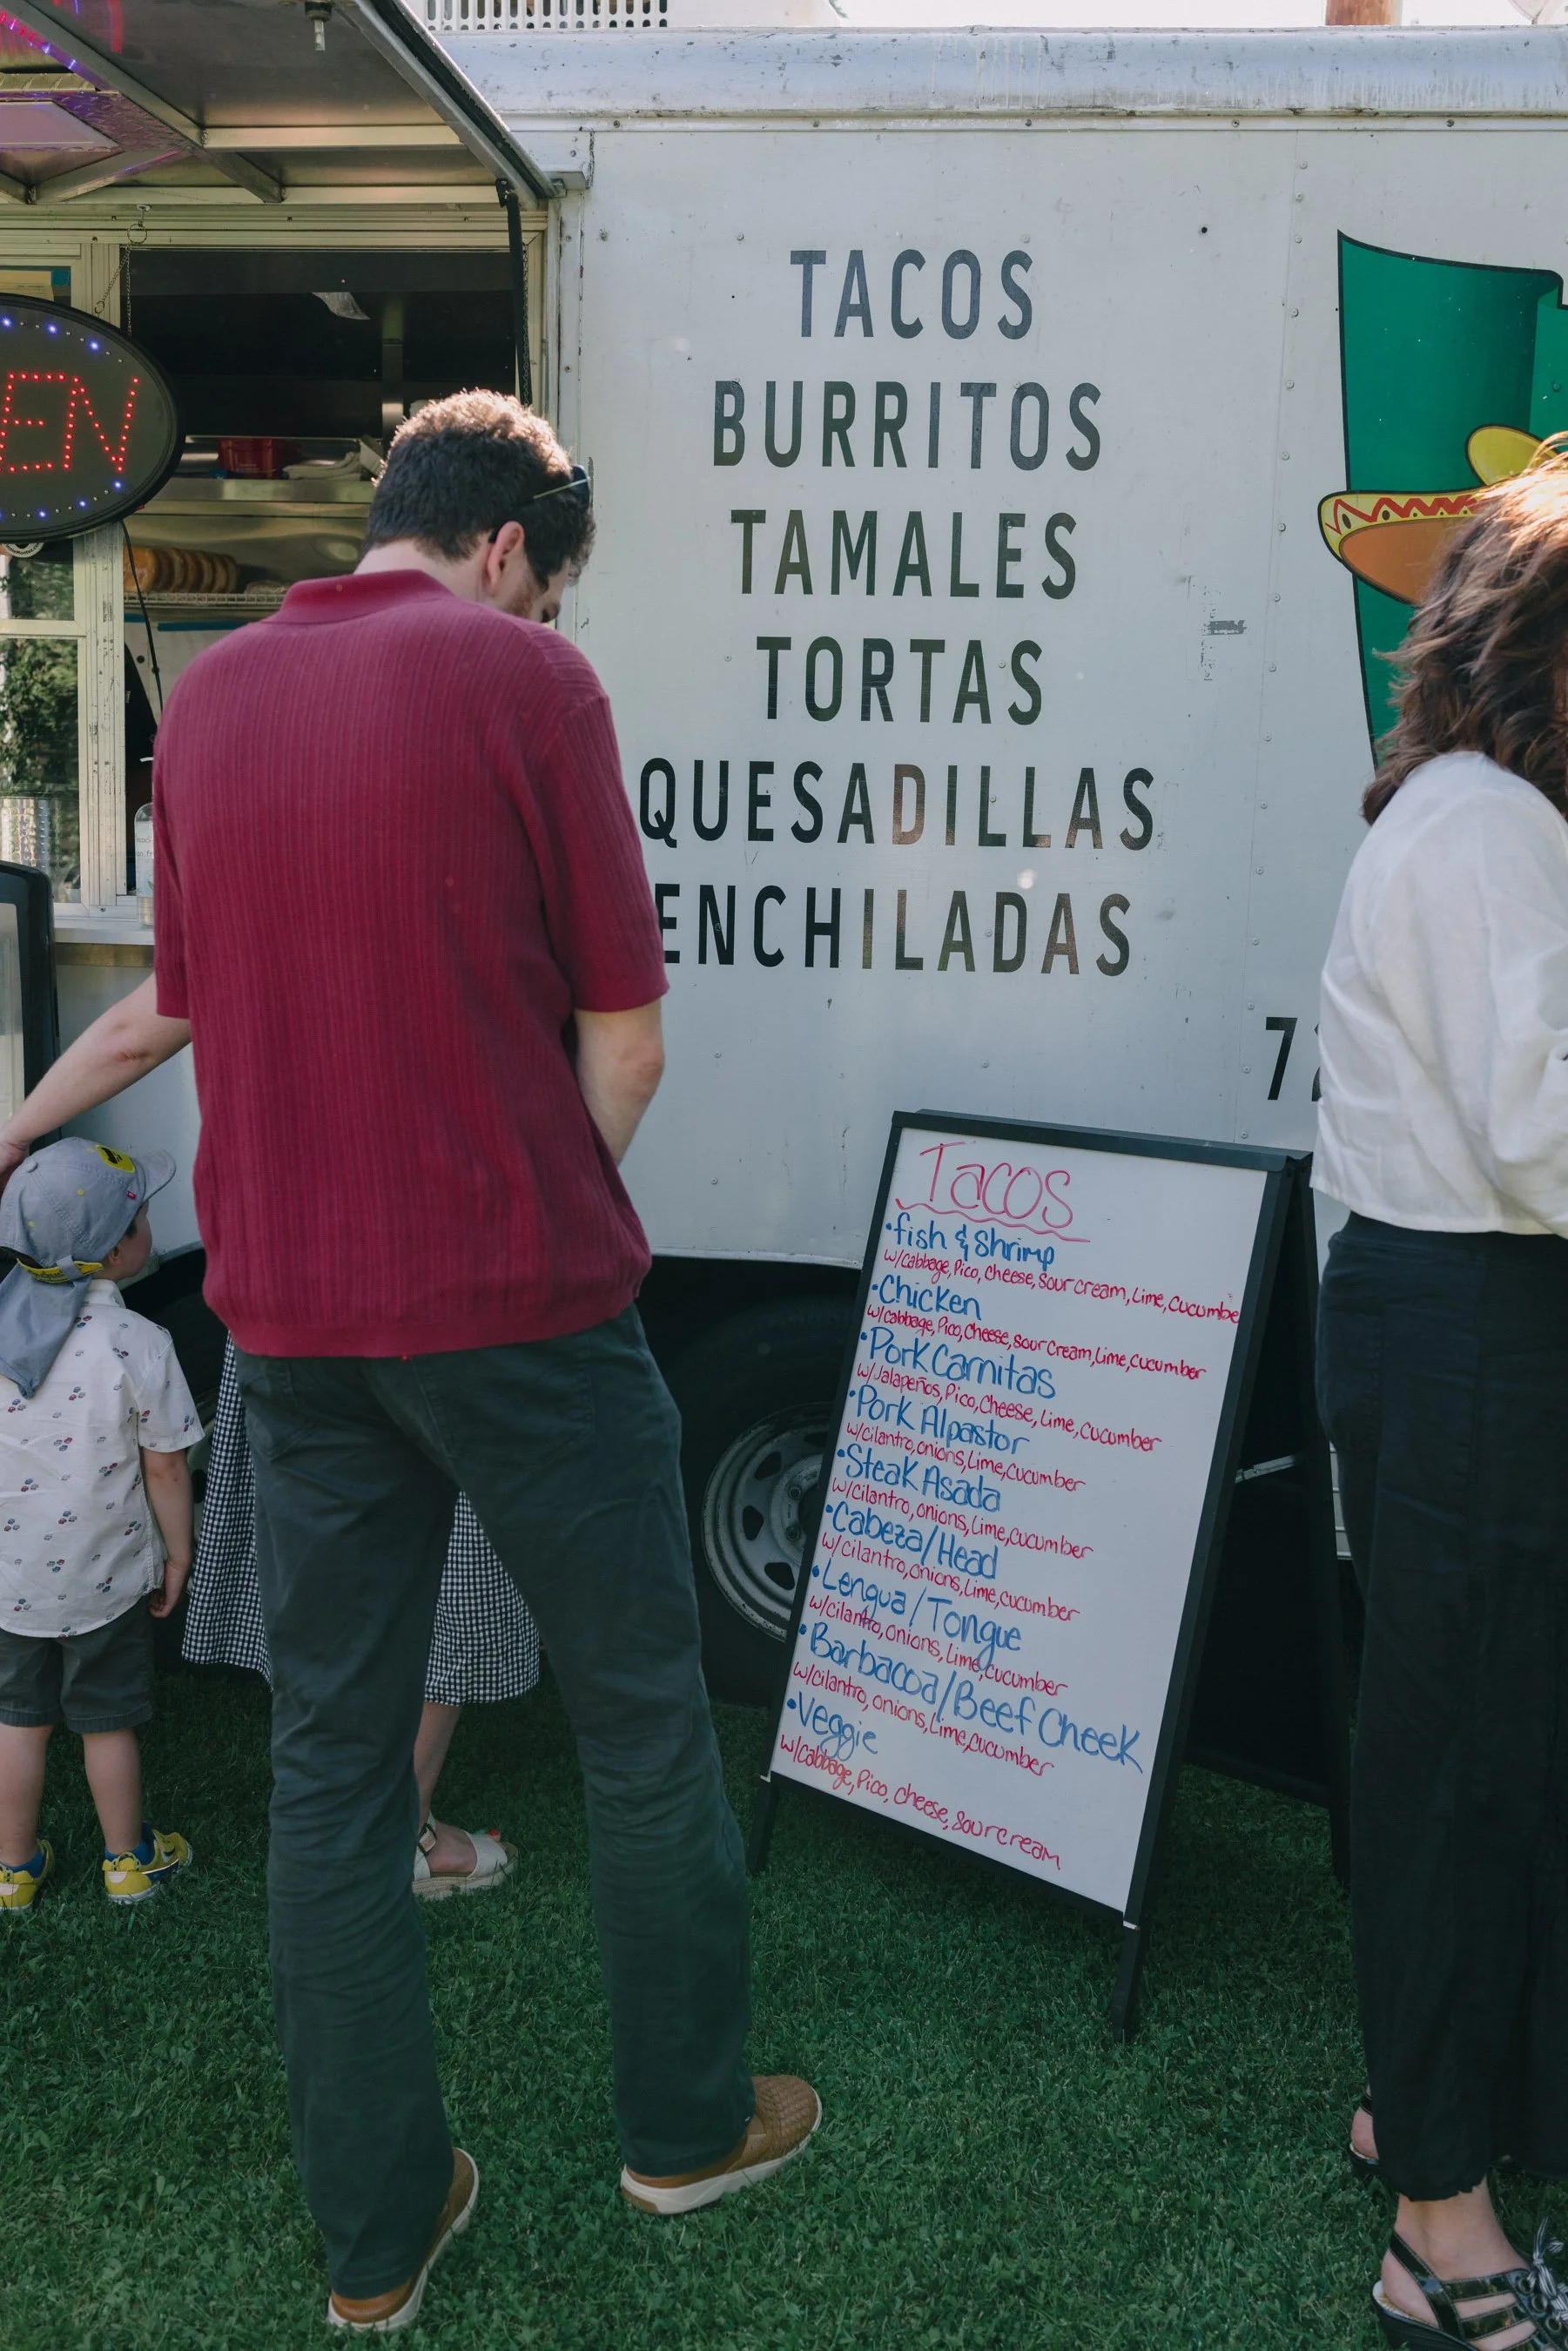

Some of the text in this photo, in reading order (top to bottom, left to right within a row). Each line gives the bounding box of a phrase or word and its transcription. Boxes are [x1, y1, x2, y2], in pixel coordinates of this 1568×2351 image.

[790, 249, 1033, 340] TACOS
[713, 380, 1101, 472] BURRITOS
[730, 509, 1077, 600] TAMALES
[757, 636, 1042, 726] TORTAS
[640, 758, 1154, 851] QUESADILLAS
[655, 883, 1131, 977] ENCHILADAS
[1265, 1016, 1322, 1101] 7
[955, 1223, 969, 1261] &
[879, 1274, 981, 1320] Chicken
[870, 1326, 1056, 1398] Pork Carnitas
[857, 1384, 915, 1430] Pork
[846, 1444, 1000, 1512] Steak Asada
